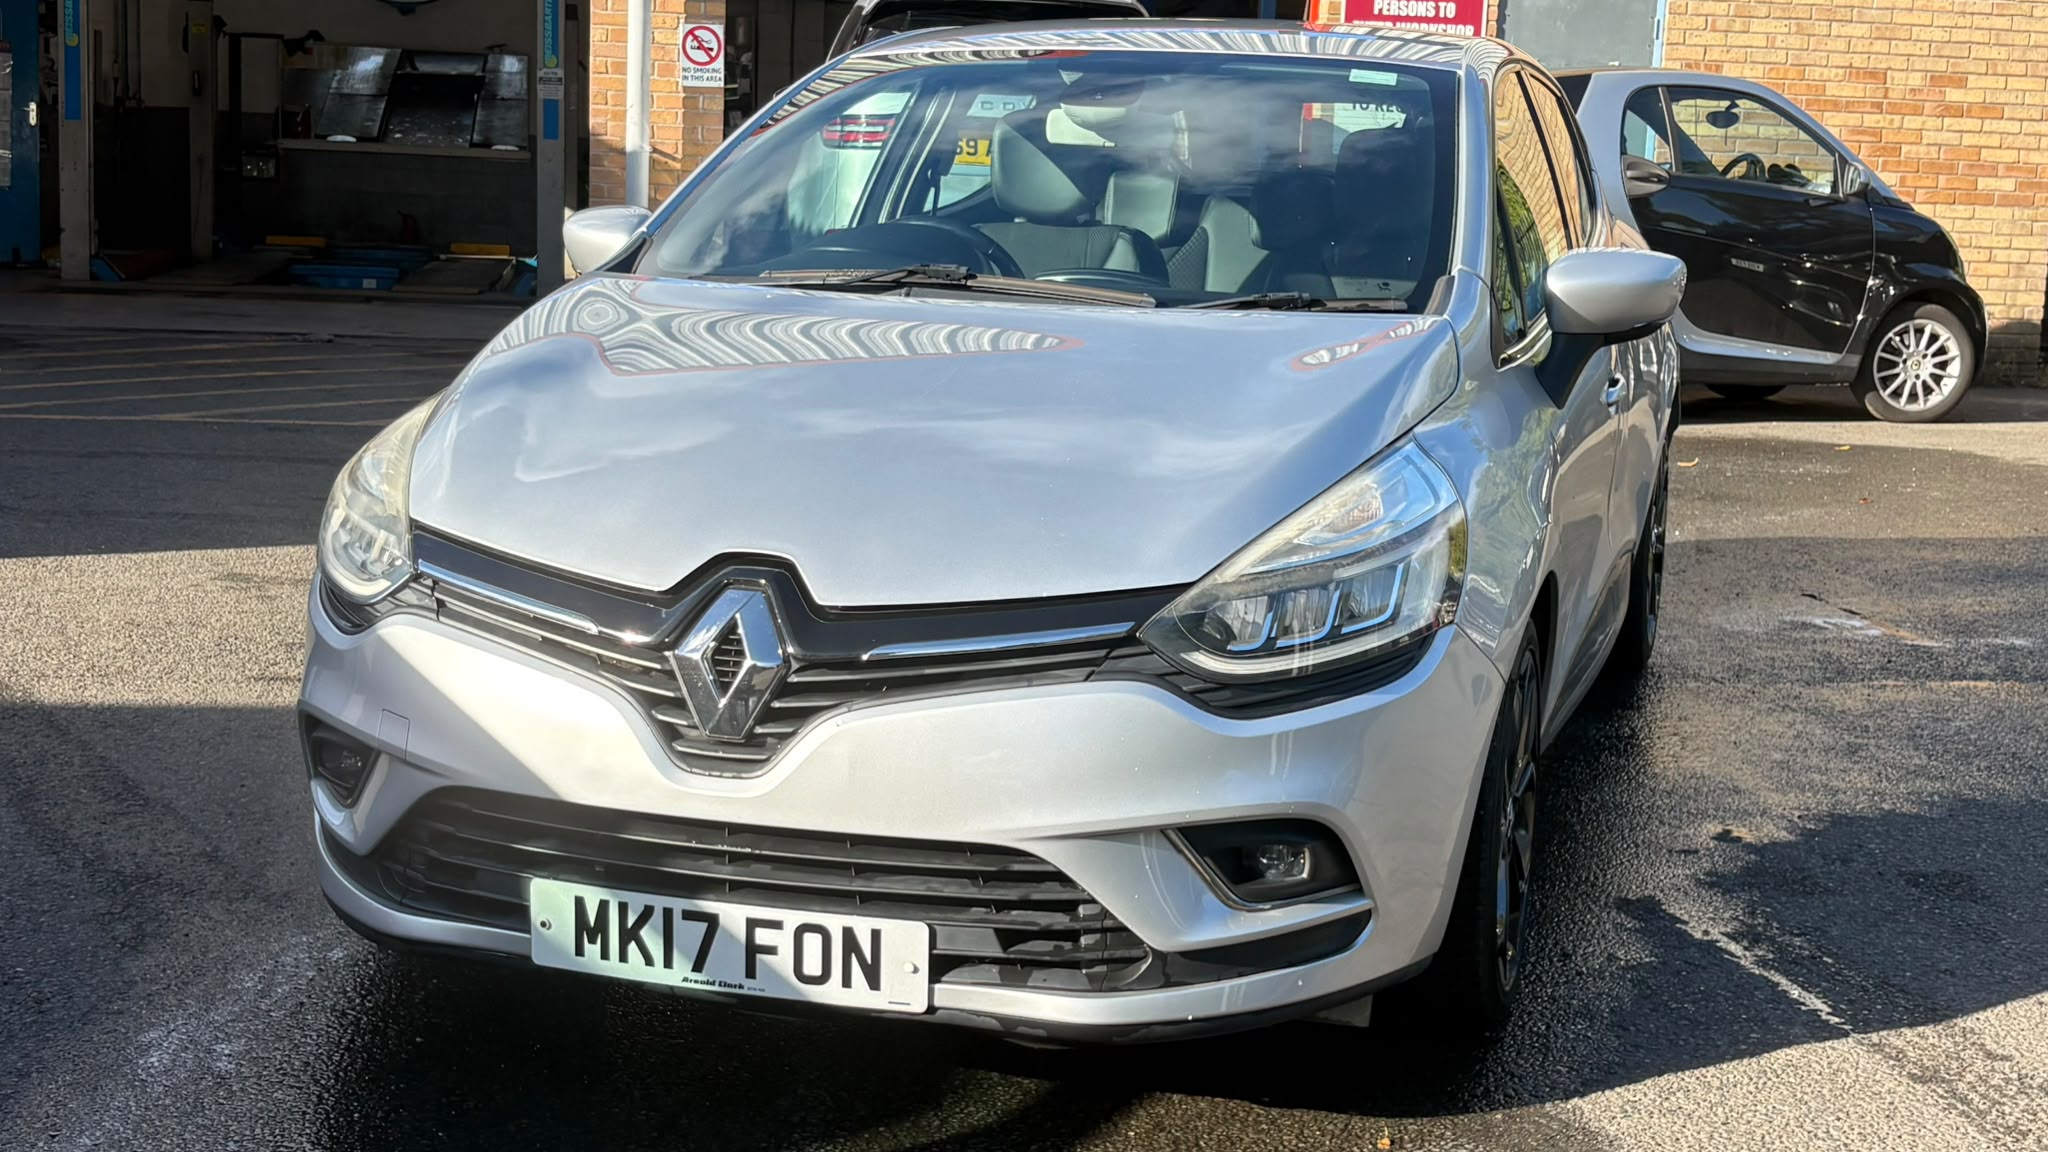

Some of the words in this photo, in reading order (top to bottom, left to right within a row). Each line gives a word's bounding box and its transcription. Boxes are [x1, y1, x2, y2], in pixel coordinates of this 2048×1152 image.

[1373, 0, 1436, 17] PERSONS
[1438, 1, 1457, 18] TO
[574, 895, 720, 973] MK17
[745, 916, 882, 991] FON
[681, 976, 716, 987] Arnold
[718, 980, 745, 990] Clark
